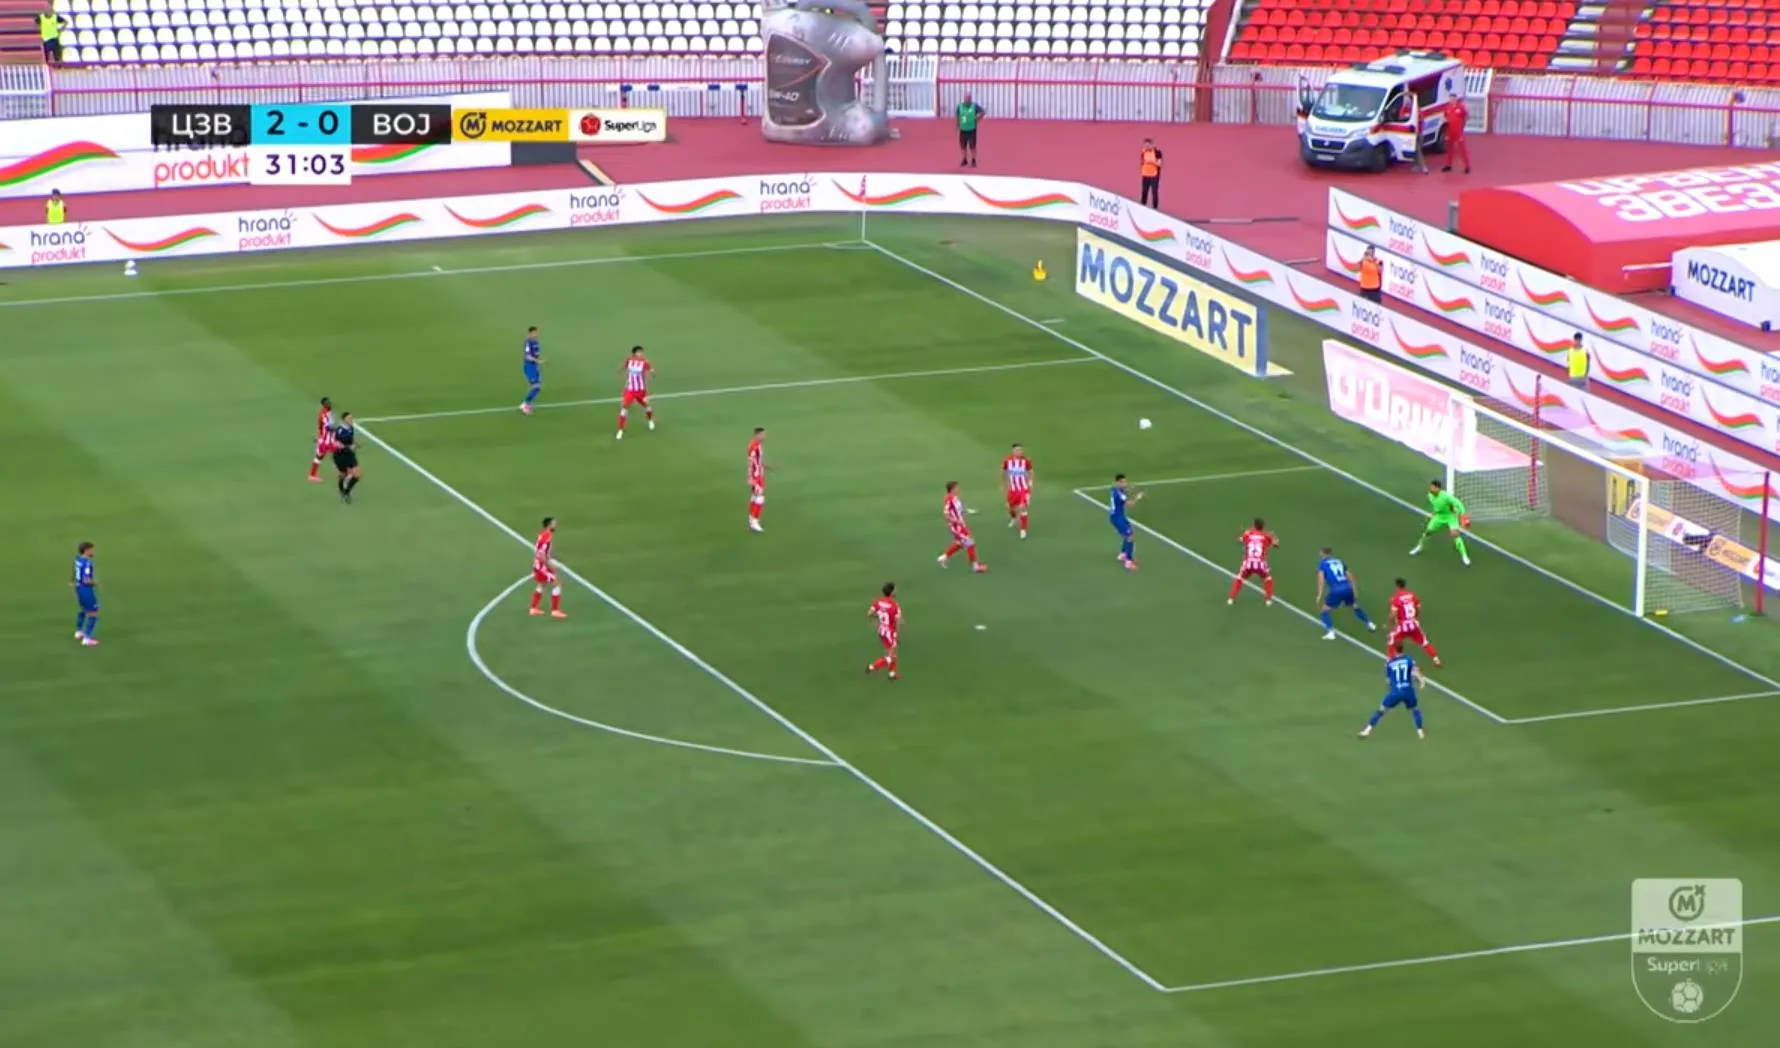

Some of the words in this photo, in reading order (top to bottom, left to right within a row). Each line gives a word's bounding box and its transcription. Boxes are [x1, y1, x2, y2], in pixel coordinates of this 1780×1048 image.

[154, 153, 251, 188] produkt
[760, 179, 811, 196] hrana
[570, 192, 620, 210] hrana
[760, 196, 811, 214] produkt
[1597, 180, 1780, 222] ЗВЕЗ
[238, 216, 292, 233] hrana
[570, 209, 620, 225] produkt
[31, 230, 86, 247] hrana
[239, 233, 292, 251] produkt
[31, 248, 86, 265] produkt
[1687, 259, 1756, 303] MOZZART
[1080, 241, 1253, 358] MOZZART
